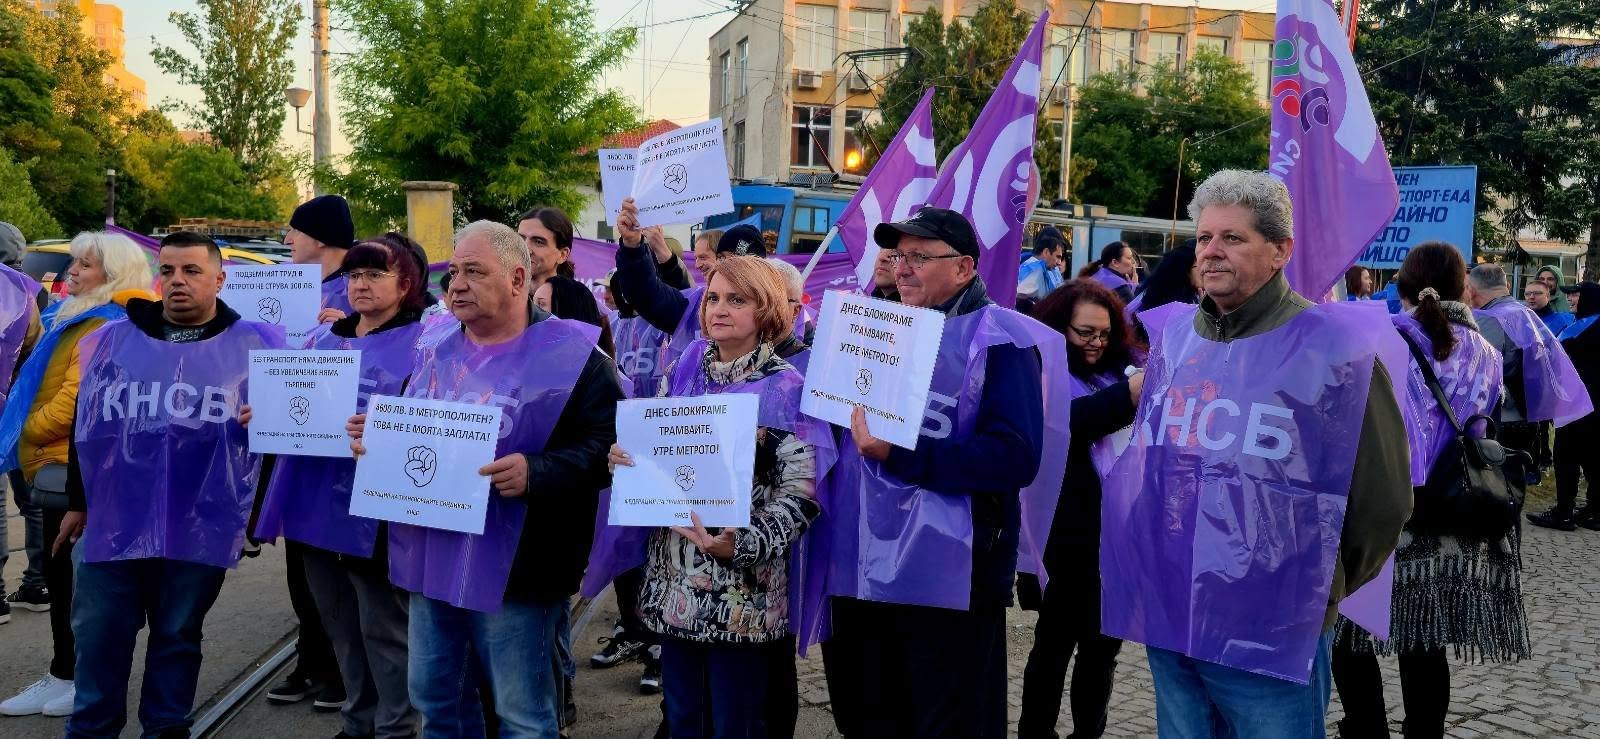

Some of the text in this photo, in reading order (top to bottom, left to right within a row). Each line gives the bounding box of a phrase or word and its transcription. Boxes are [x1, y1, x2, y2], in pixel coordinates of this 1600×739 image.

[235, 270, 278, 278] ПОДЗЕМНИЯТ
[280, 270, 297, 278] ТРУД
[840, 302, 914, 327] ДНЕС БЛОКИРАМЕ
[850, 323, 896, 346] ТРАМВАИТЕ,
[317, 356, 354, 364] ДВИЖЕНИЕ
[839, 342, 900, 367] УТРЕ МЕТРОТО!
[318, 369, 339, 377] НЯМА
[103, 381, 232, 424] КНСБ
[375, 403, 494, 424] 4600 ЛВ. В МЕТРОПОЛИТЕН?
[644, 404, 728, 420] ДНЕС БЛОКИРАМЕ
[373, 420, 491, 442] ТОВА НЕ Е МОЯТА ЗАПЛАТА!
[659, 424, 713, 436] ТРАМВАИТЕ,
[653, 443, 720, 456] УТРЕ МЕТРОТО!
